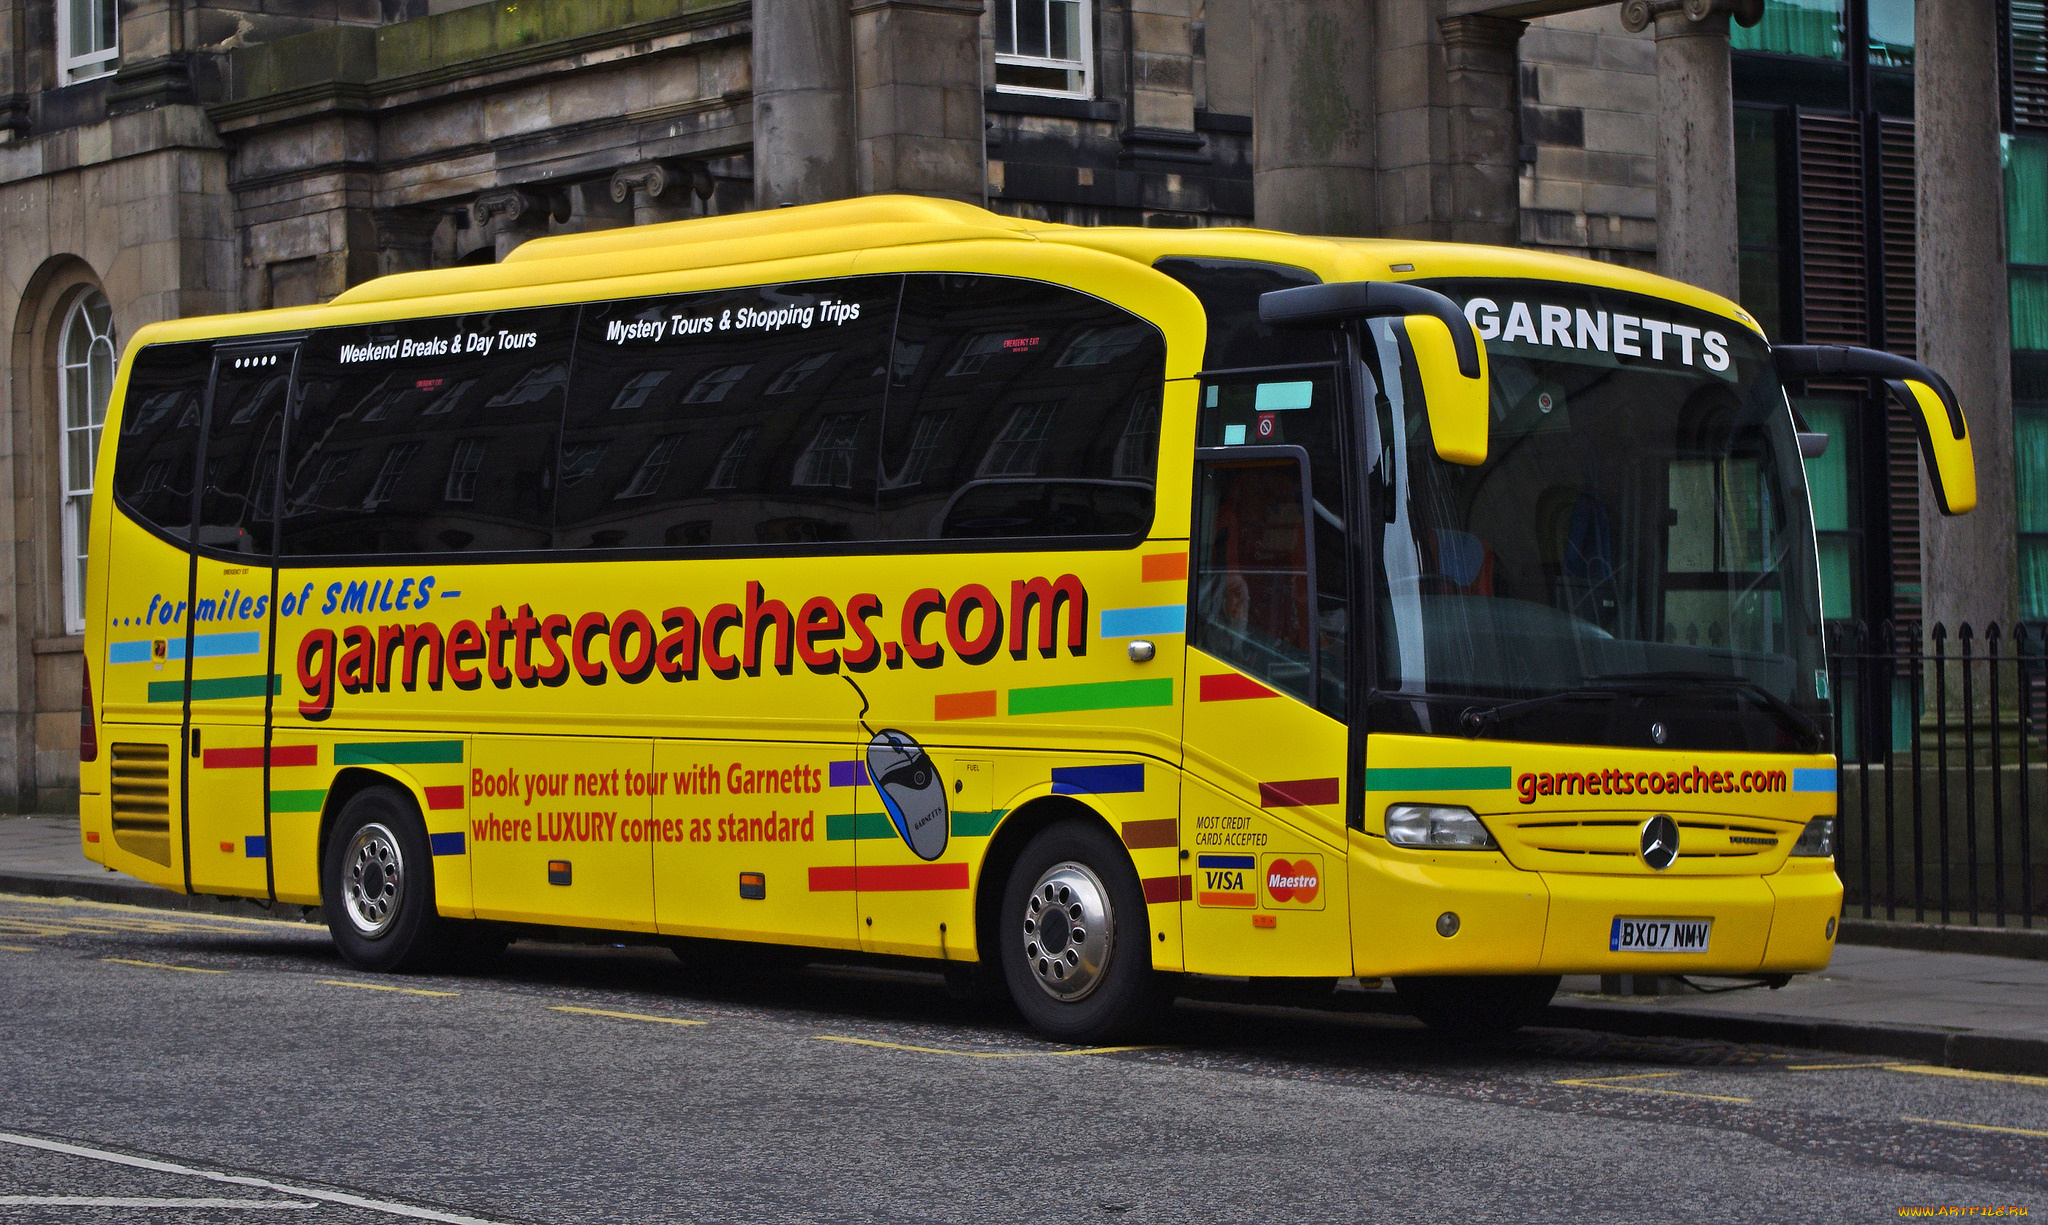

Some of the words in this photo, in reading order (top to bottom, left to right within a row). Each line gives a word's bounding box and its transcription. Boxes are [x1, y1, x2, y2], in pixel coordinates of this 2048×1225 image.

[606, 319, 666, 345] Mystery
[671, 314, 713, 335] Tours
[719, 309, 731, 330] &
[735, 303, 813, 331] Shopping
[819, 300, 861, 323] Trips
[1464, 298, 1730, 372] GARNETTS
[340, 338, 399, 364] Weekend
[401, 335, 449, 358] Breaks
[452, 334, 462, 354] &
[466, 333, 493, 357] Day
[498, 330, 537, 350] Tours
[194, 588, 269, 621] miles
[280, 582, 314, 616] of
[321, 575, 436, 615] SMILES
[297, 573, 1087, 722] garnettscoaches.com
[472, 768, 519, 797] Book
[524, 775, 569, 806] your
[574, 767, 619, 797] next
[624, 767, 669, 797] tour
[673, 764, 721, 795] with
[726, 762, 822, 795] Garnetts
[966, 764, 980, 772] FUEL
[1517, 766, 1787, 804] garnettscoaches.com
[472, 812, 533, 842] where
[536, 811, 618, 842] LUXURY
[620, 821, 684, 842] comes
[689, 818, 713, 842] as
[717, 810, 815, 842] standard
[914, 806, 943, 831] GARNETTS
[1196, 816, 1220, 830] MOST
[1221, 816, 1251, 830] CREDIT
[1195, 832, 1223, 846] CARDS
[1224, 832, 1268, 846] ACCEPTED
[1205, 871, 1244, 891] VISA
[1268, 873, 1317, 888] Maestro
[1622, 922, 1671, 948] BX07
[1673, 923, 1708, 948] NMV
